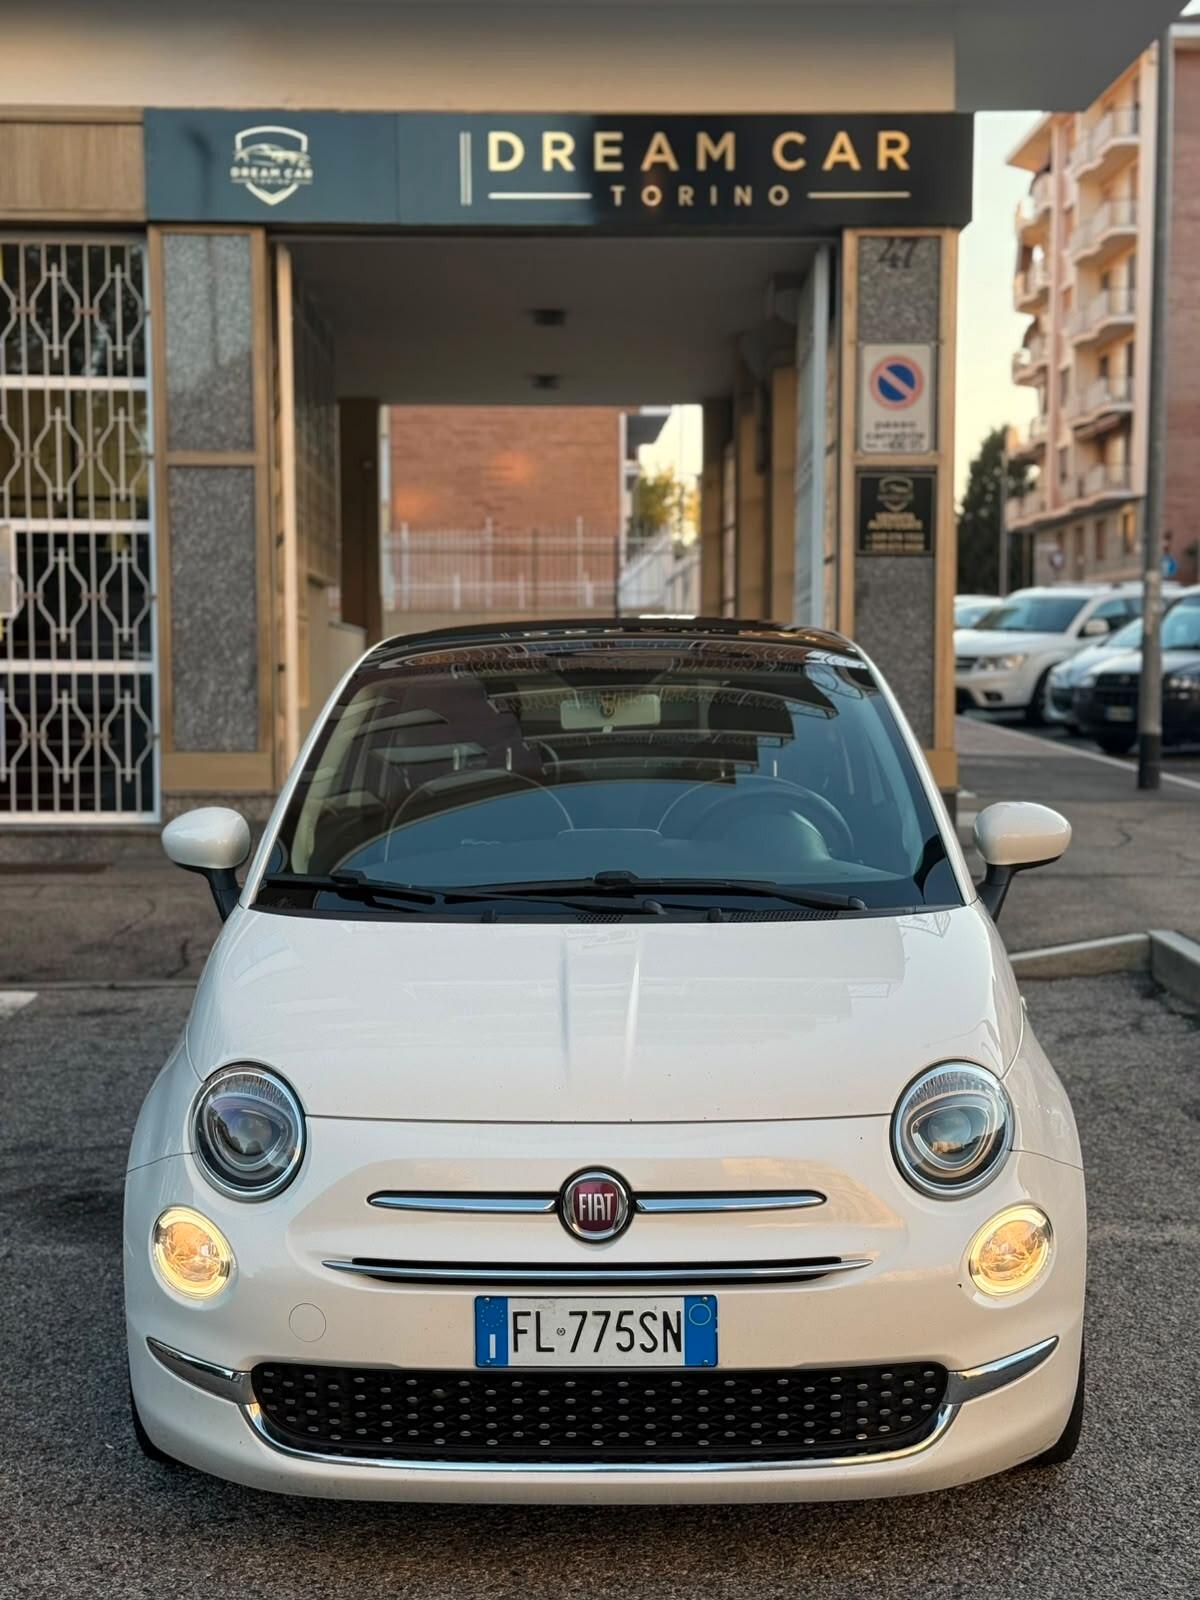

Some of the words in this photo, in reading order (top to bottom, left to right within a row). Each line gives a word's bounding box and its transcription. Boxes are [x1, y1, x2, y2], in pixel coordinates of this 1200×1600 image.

[487, 130, 736, 172] DREAM
[771, 130, 911, 172] CAR
[610, 184, 790, 207] TORINO
[578, 1193, 614, 1221] FIAT
